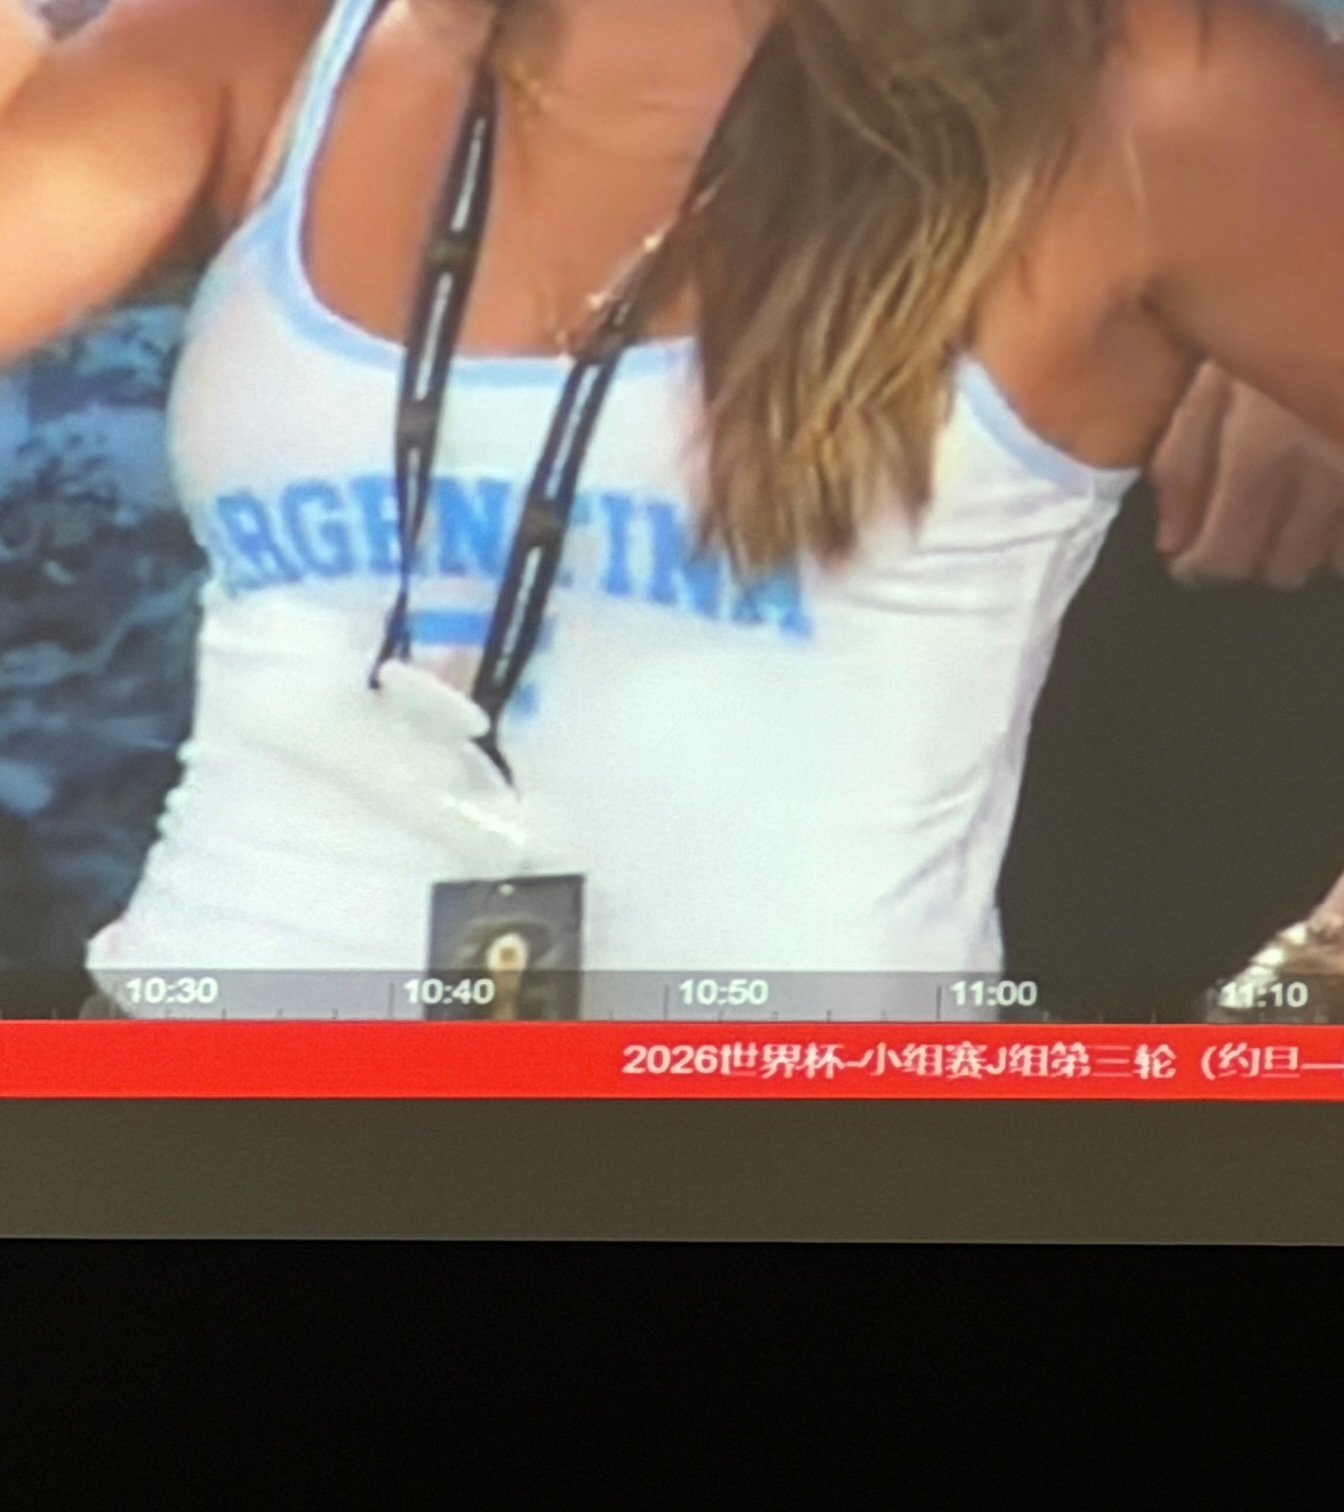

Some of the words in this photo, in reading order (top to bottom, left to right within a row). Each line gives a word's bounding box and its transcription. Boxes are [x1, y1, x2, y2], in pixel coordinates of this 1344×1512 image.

[127, 977, 218, 1006] 10:30
[404, 977, 495, 1005] 10:40
[679, 977, 770, 1006] 10:50
[950, 979, 1038, 1008] 11:00
[1221, 981, 1308, 1009] 11:10
